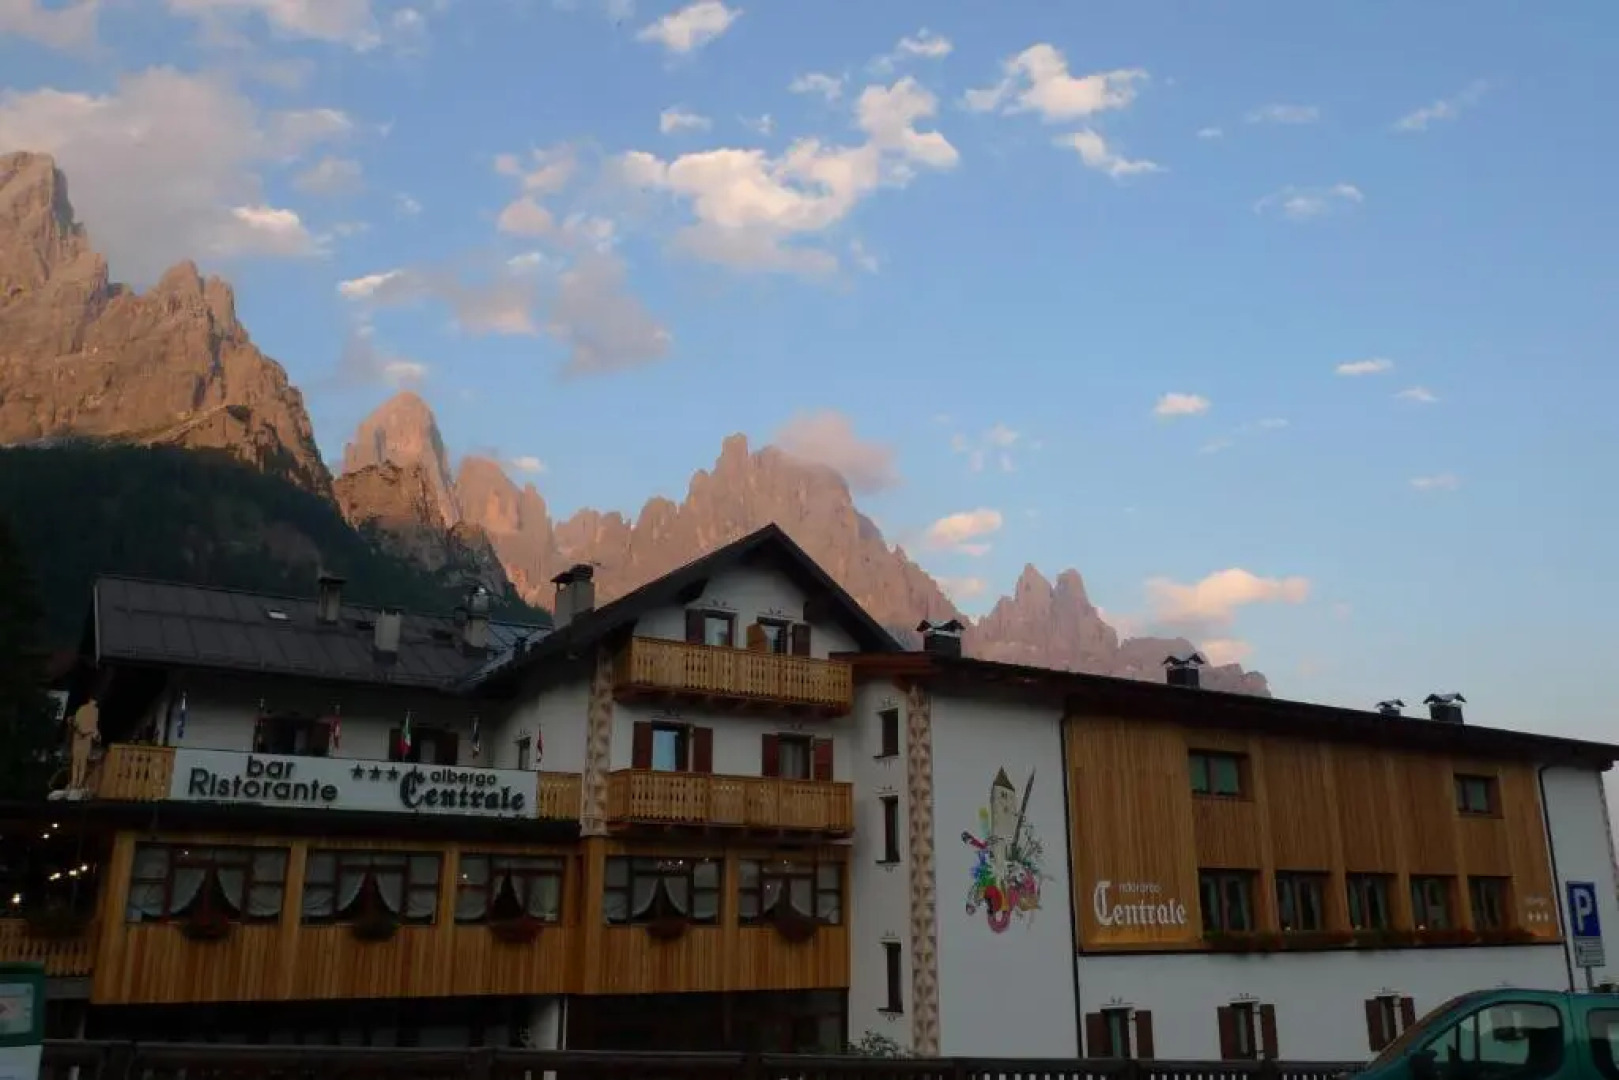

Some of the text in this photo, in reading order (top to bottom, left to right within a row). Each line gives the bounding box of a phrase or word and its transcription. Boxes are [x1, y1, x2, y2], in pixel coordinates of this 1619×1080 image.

[188, 767, 338, 801] Ristorante
[246, 755, 295, 780] bar
[401, 765, 525, 809] Centrale
[429, 770, 498, 786] albergo
[1094, 880, 1186, 925] Centrale
[1573, 888, 1593, 932] P
